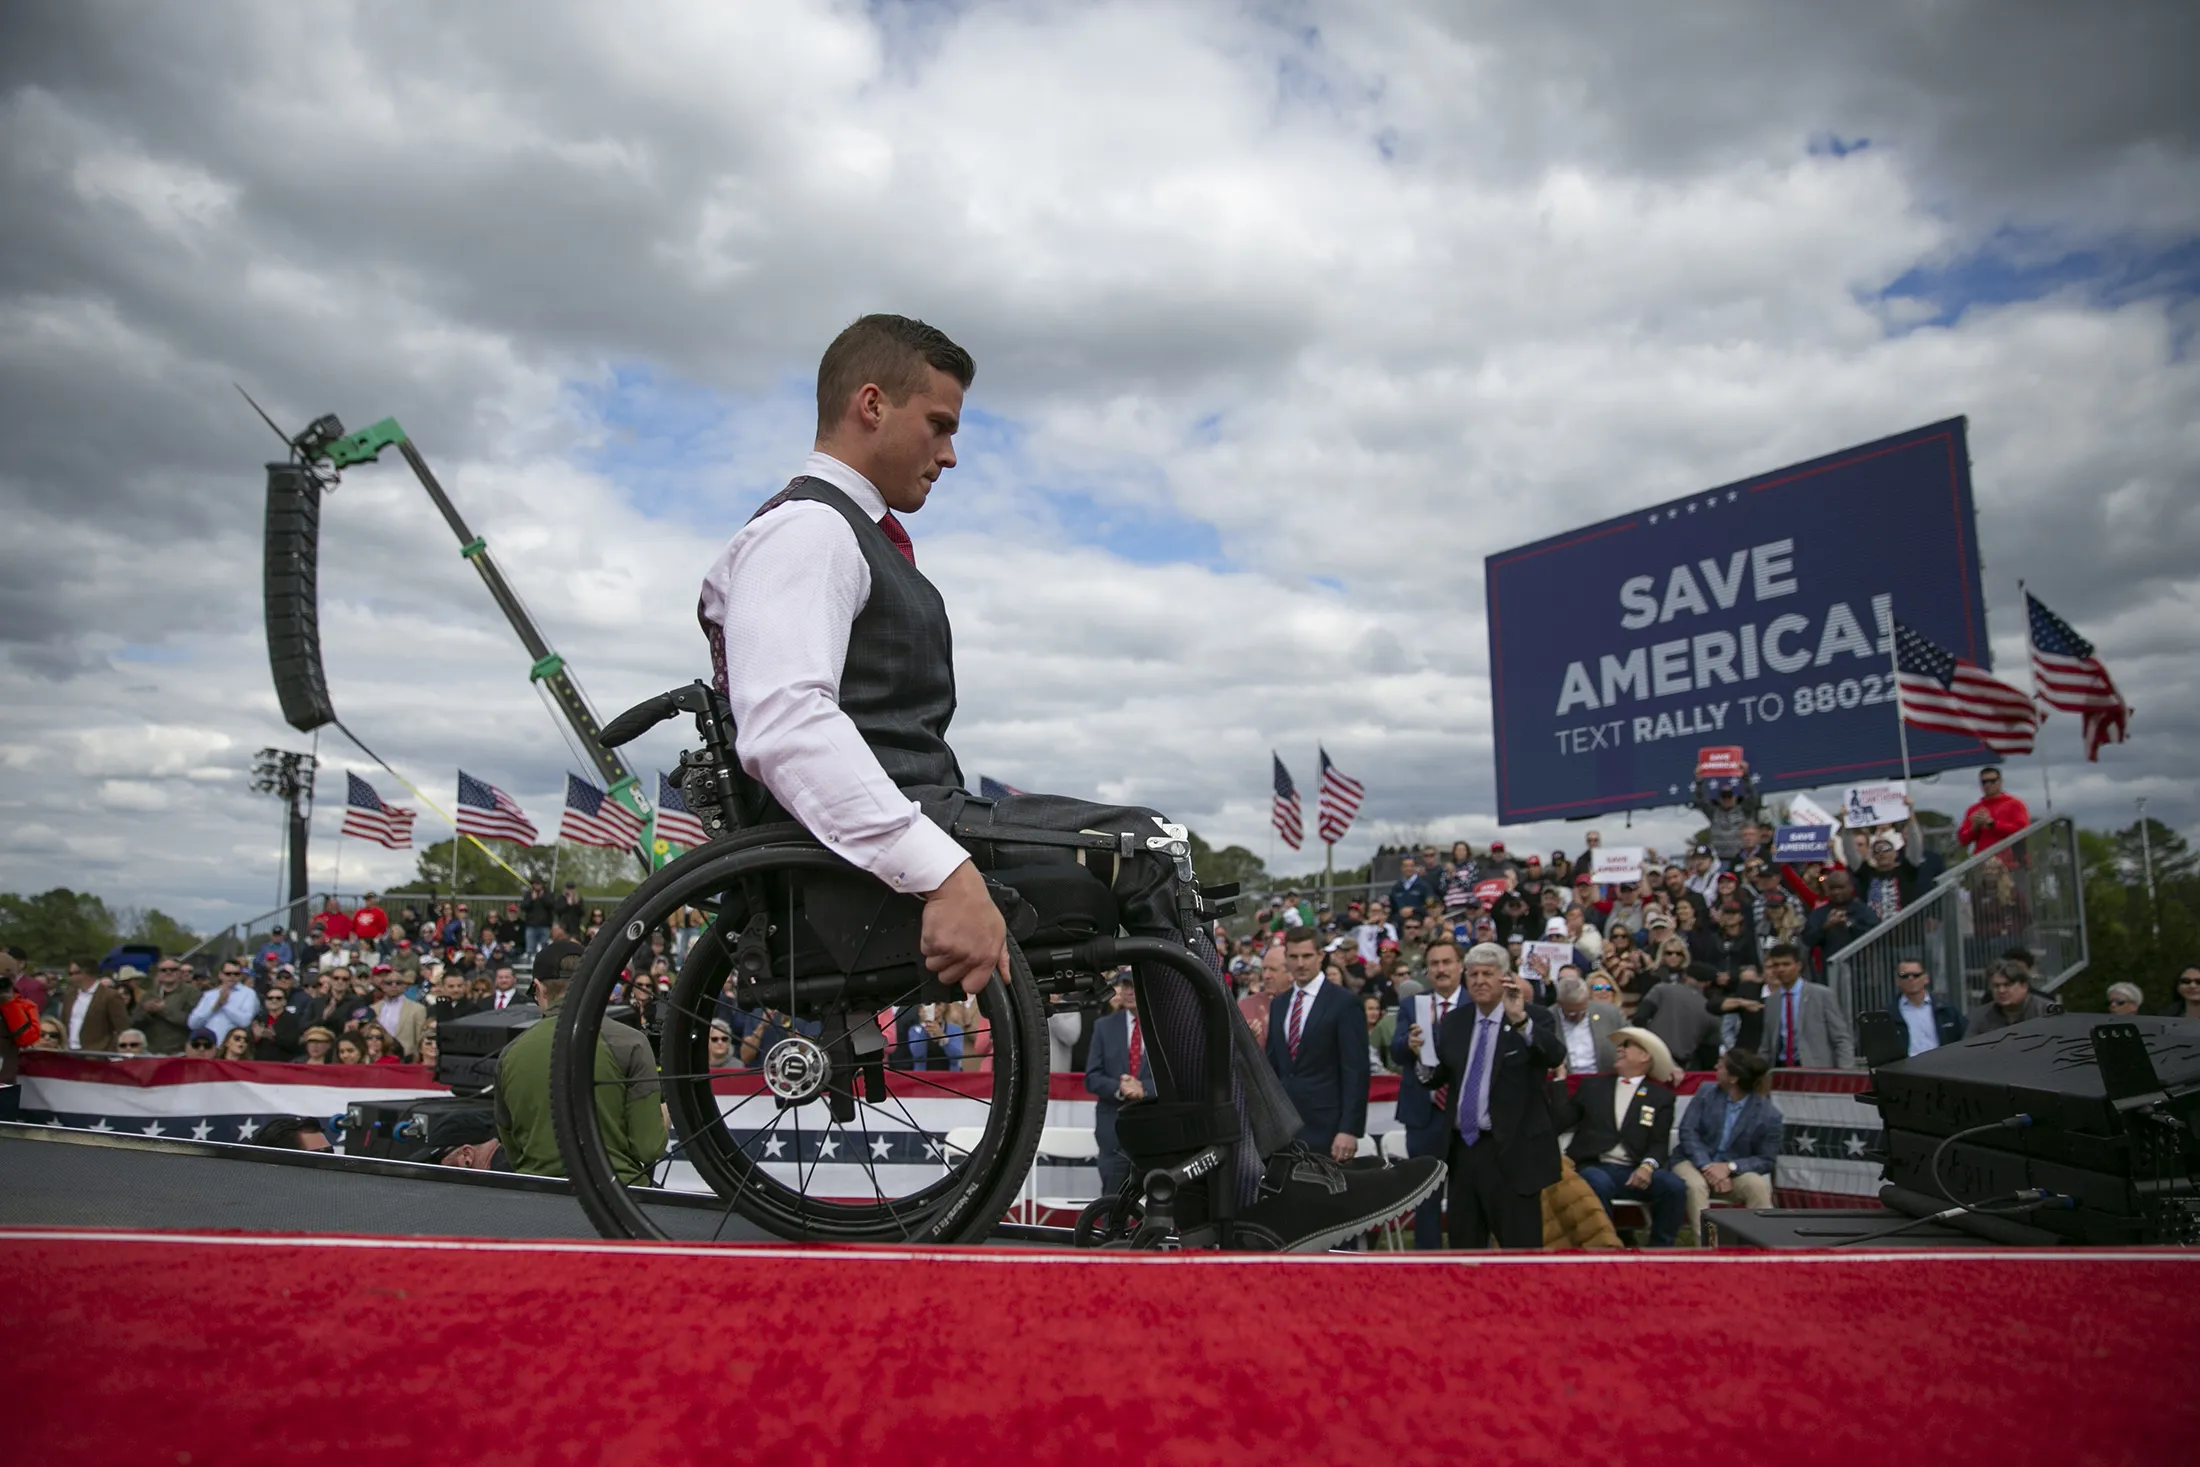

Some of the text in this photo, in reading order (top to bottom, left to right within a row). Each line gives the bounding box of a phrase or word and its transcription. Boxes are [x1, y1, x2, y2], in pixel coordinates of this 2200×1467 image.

[1619, 538, 1798, 630] SAVE
[1555, 592, 1896, 717] AMERICA!
[1554, 719, 1625, 756] TEXT
[1632, 702, 1730, 744] RALLY
[1738, 692, 1785, 725] TO
[1777, 841, 1828, 853] AMERICA!
[1789, 831, 1817, 842] SAVE
